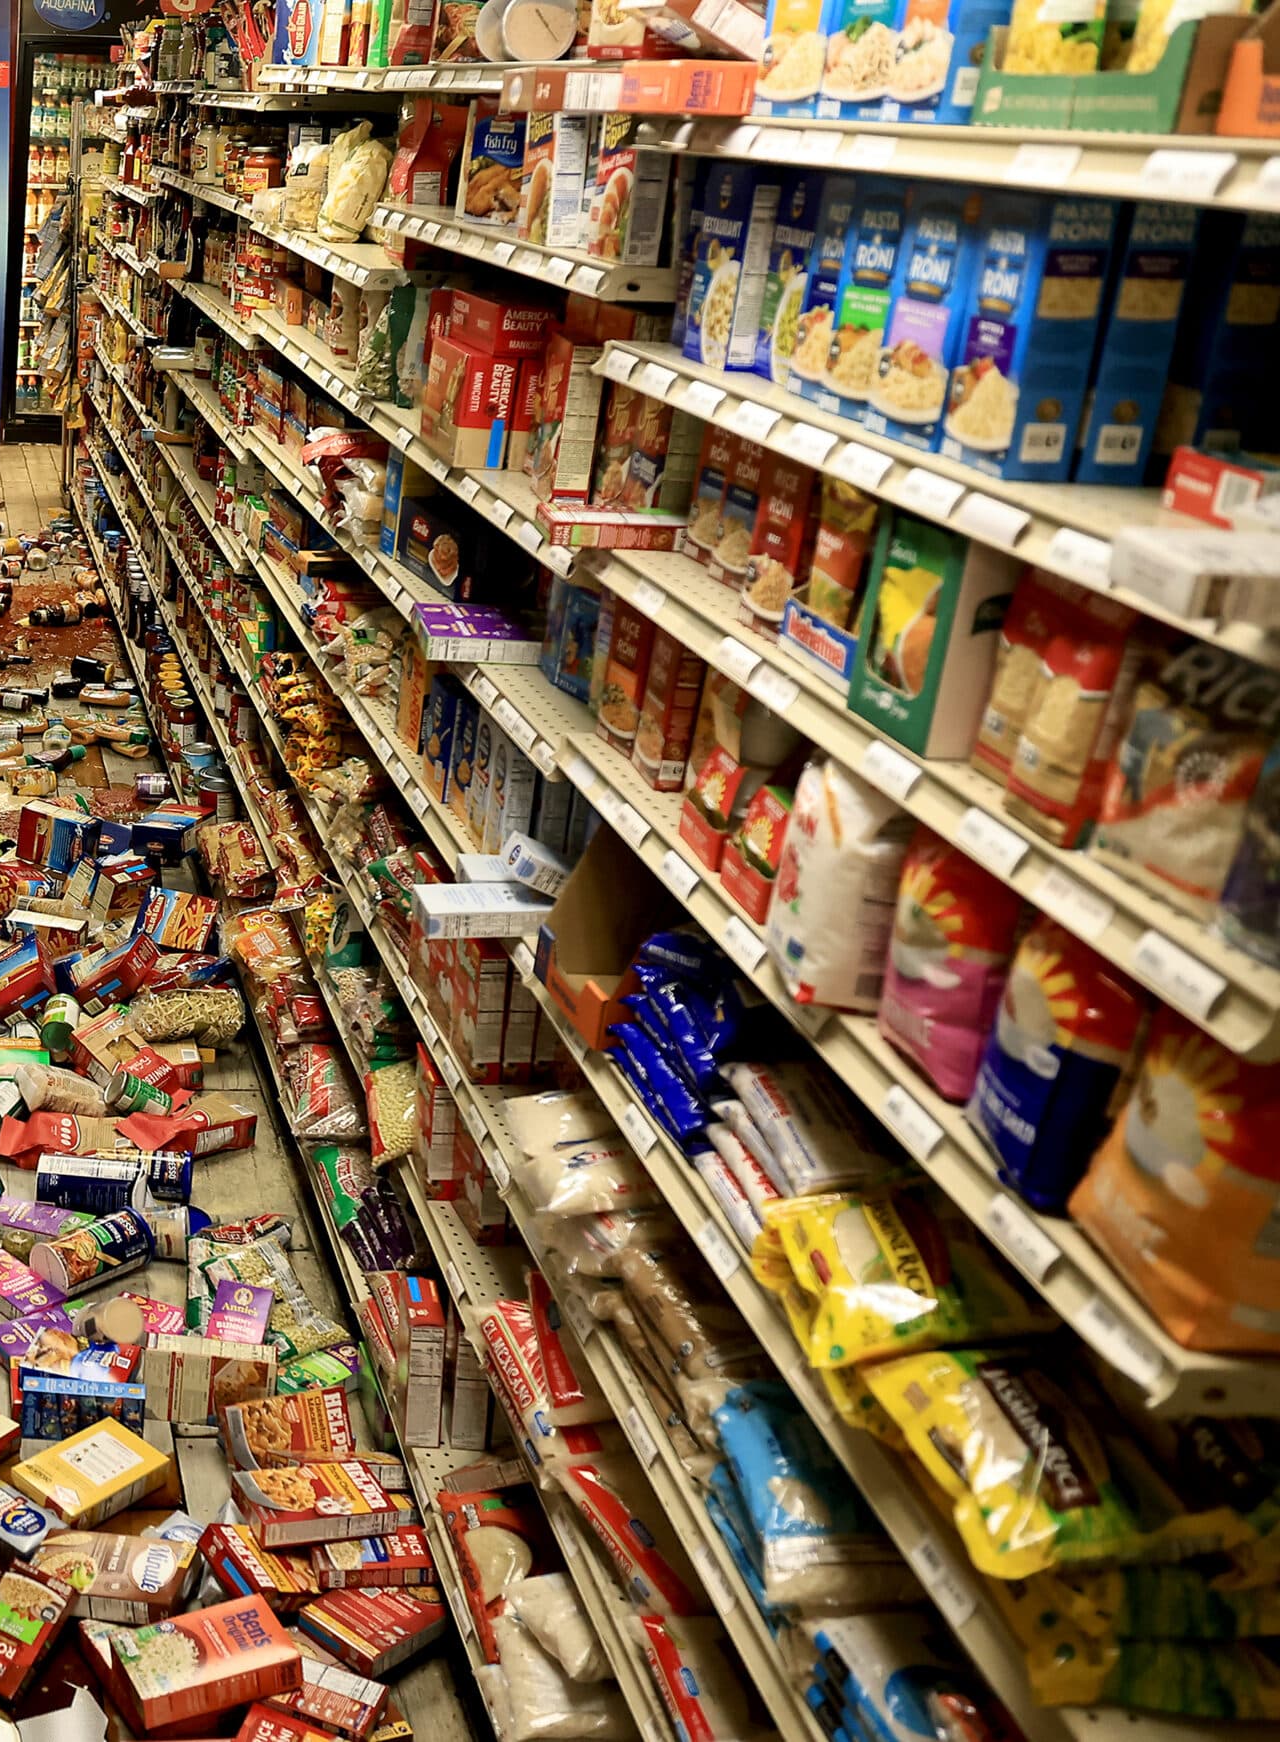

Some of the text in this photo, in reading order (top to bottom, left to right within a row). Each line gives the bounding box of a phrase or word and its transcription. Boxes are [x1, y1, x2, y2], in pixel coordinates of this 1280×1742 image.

[41, 0, 97, 16] AQUAFINA
[484, 134, 518, 153] fish fry
[863, 208, 900, 232] PASTA
[919, 218, 958, 243] PASTA
[1049, 220, 1112, 241] RONI
[856, 244, 895, 270] RONI
[910, 253, 952, 285] RONI
[982, 267, 1019, 300] RONI
[502, 319, 544, 332] BEAUTY
[471, 371, 485, 413] MANICOTTI
[488, 363, 506, 404] BEAUTY
[497, 364, 516, 419] AMERICAN
[767, 499, 794, 520] RONI
[1160, 646, 1280, 724] RIC
[896, 1252, 927, 1298] RIC
[222, 1302, 259, 1317] Annie's
[482, 1317, 497, 1341] EL
[493, 1340, 534, 1410] MEXICANO
[323, 1391, 349, 1459] HELPE
[983, 1368, 1085, 1502] JASMINE RICE
[340, 1461, 388, 1509] HELPER
[220, 1526, 276, 1588] HELPER
[387, 1535, 406, 1557] RONI
[405, 1534, 425, 1556] RICE
[140, 1546, 170, 1593] Minute
[222, 1615, 251, 1651] Original
[236, 1608, 272, 1648] Ben's
